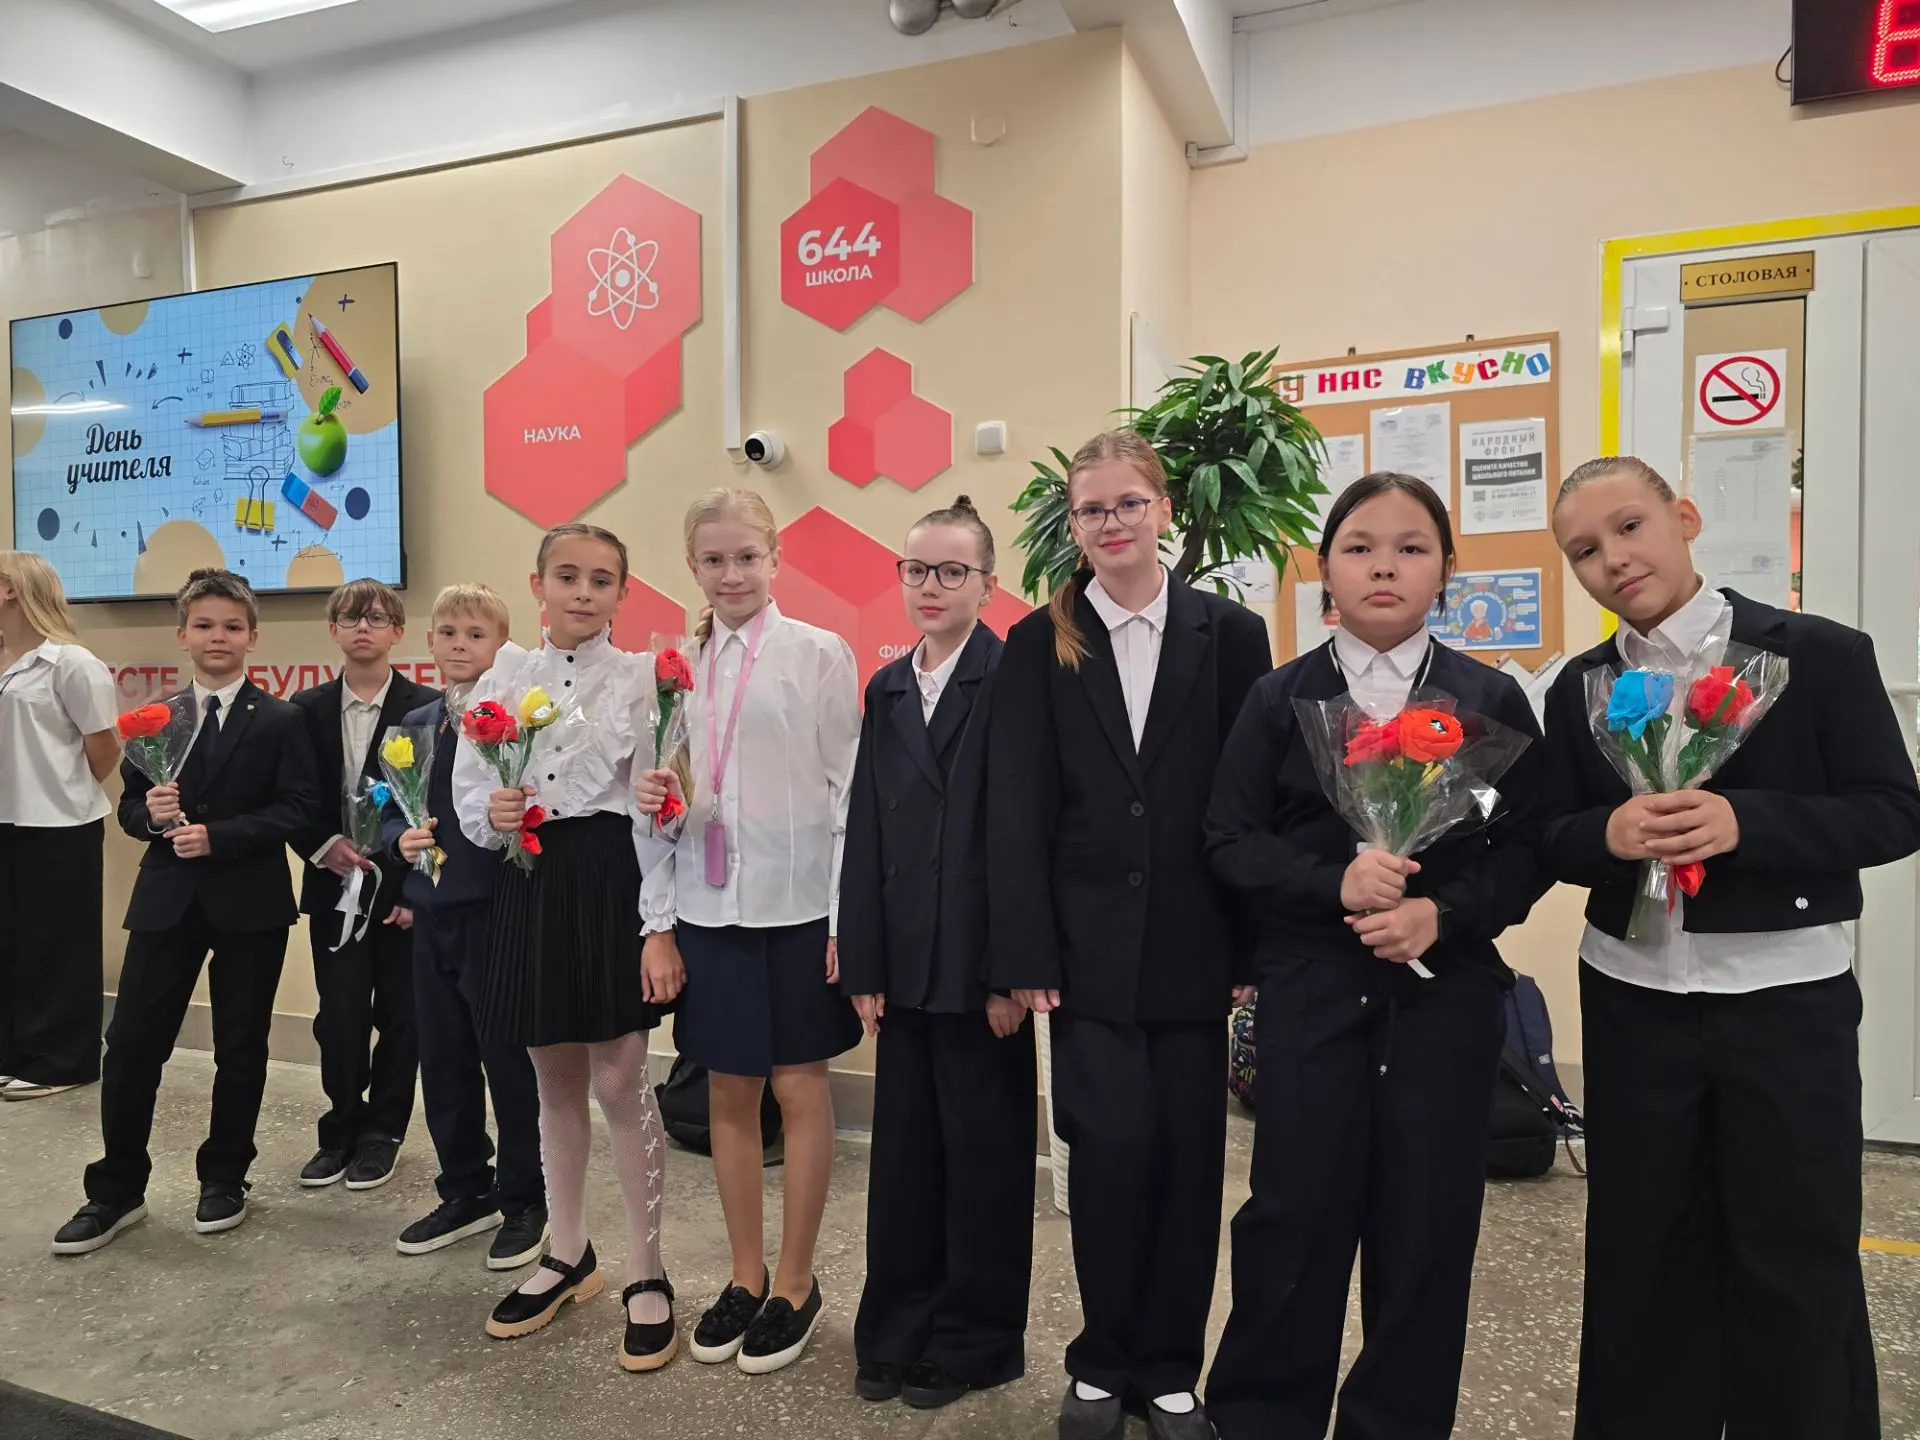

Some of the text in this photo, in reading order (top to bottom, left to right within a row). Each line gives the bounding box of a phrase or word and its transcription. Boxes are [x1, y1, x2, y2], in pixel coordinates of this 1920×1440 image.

[797, 222, 882, 266] 644
[804, 265, 873, 287] ШКОЛА
[1696, 266, 1798, 288] СТОЛОВАЯ
[1282, 351, 1551, 403] У НАС ВКУСНО
[85, 423, 142, 456] День
[523, 424, 582, 444] НАУКА
[1471, 431, 1535, 447] НАРОДНЫЙ
[1484, 444, 1522, 456] ФРОНТ
[66, 454, 172, 494] учителя
[108, 666, 179, 698] СТЕ
